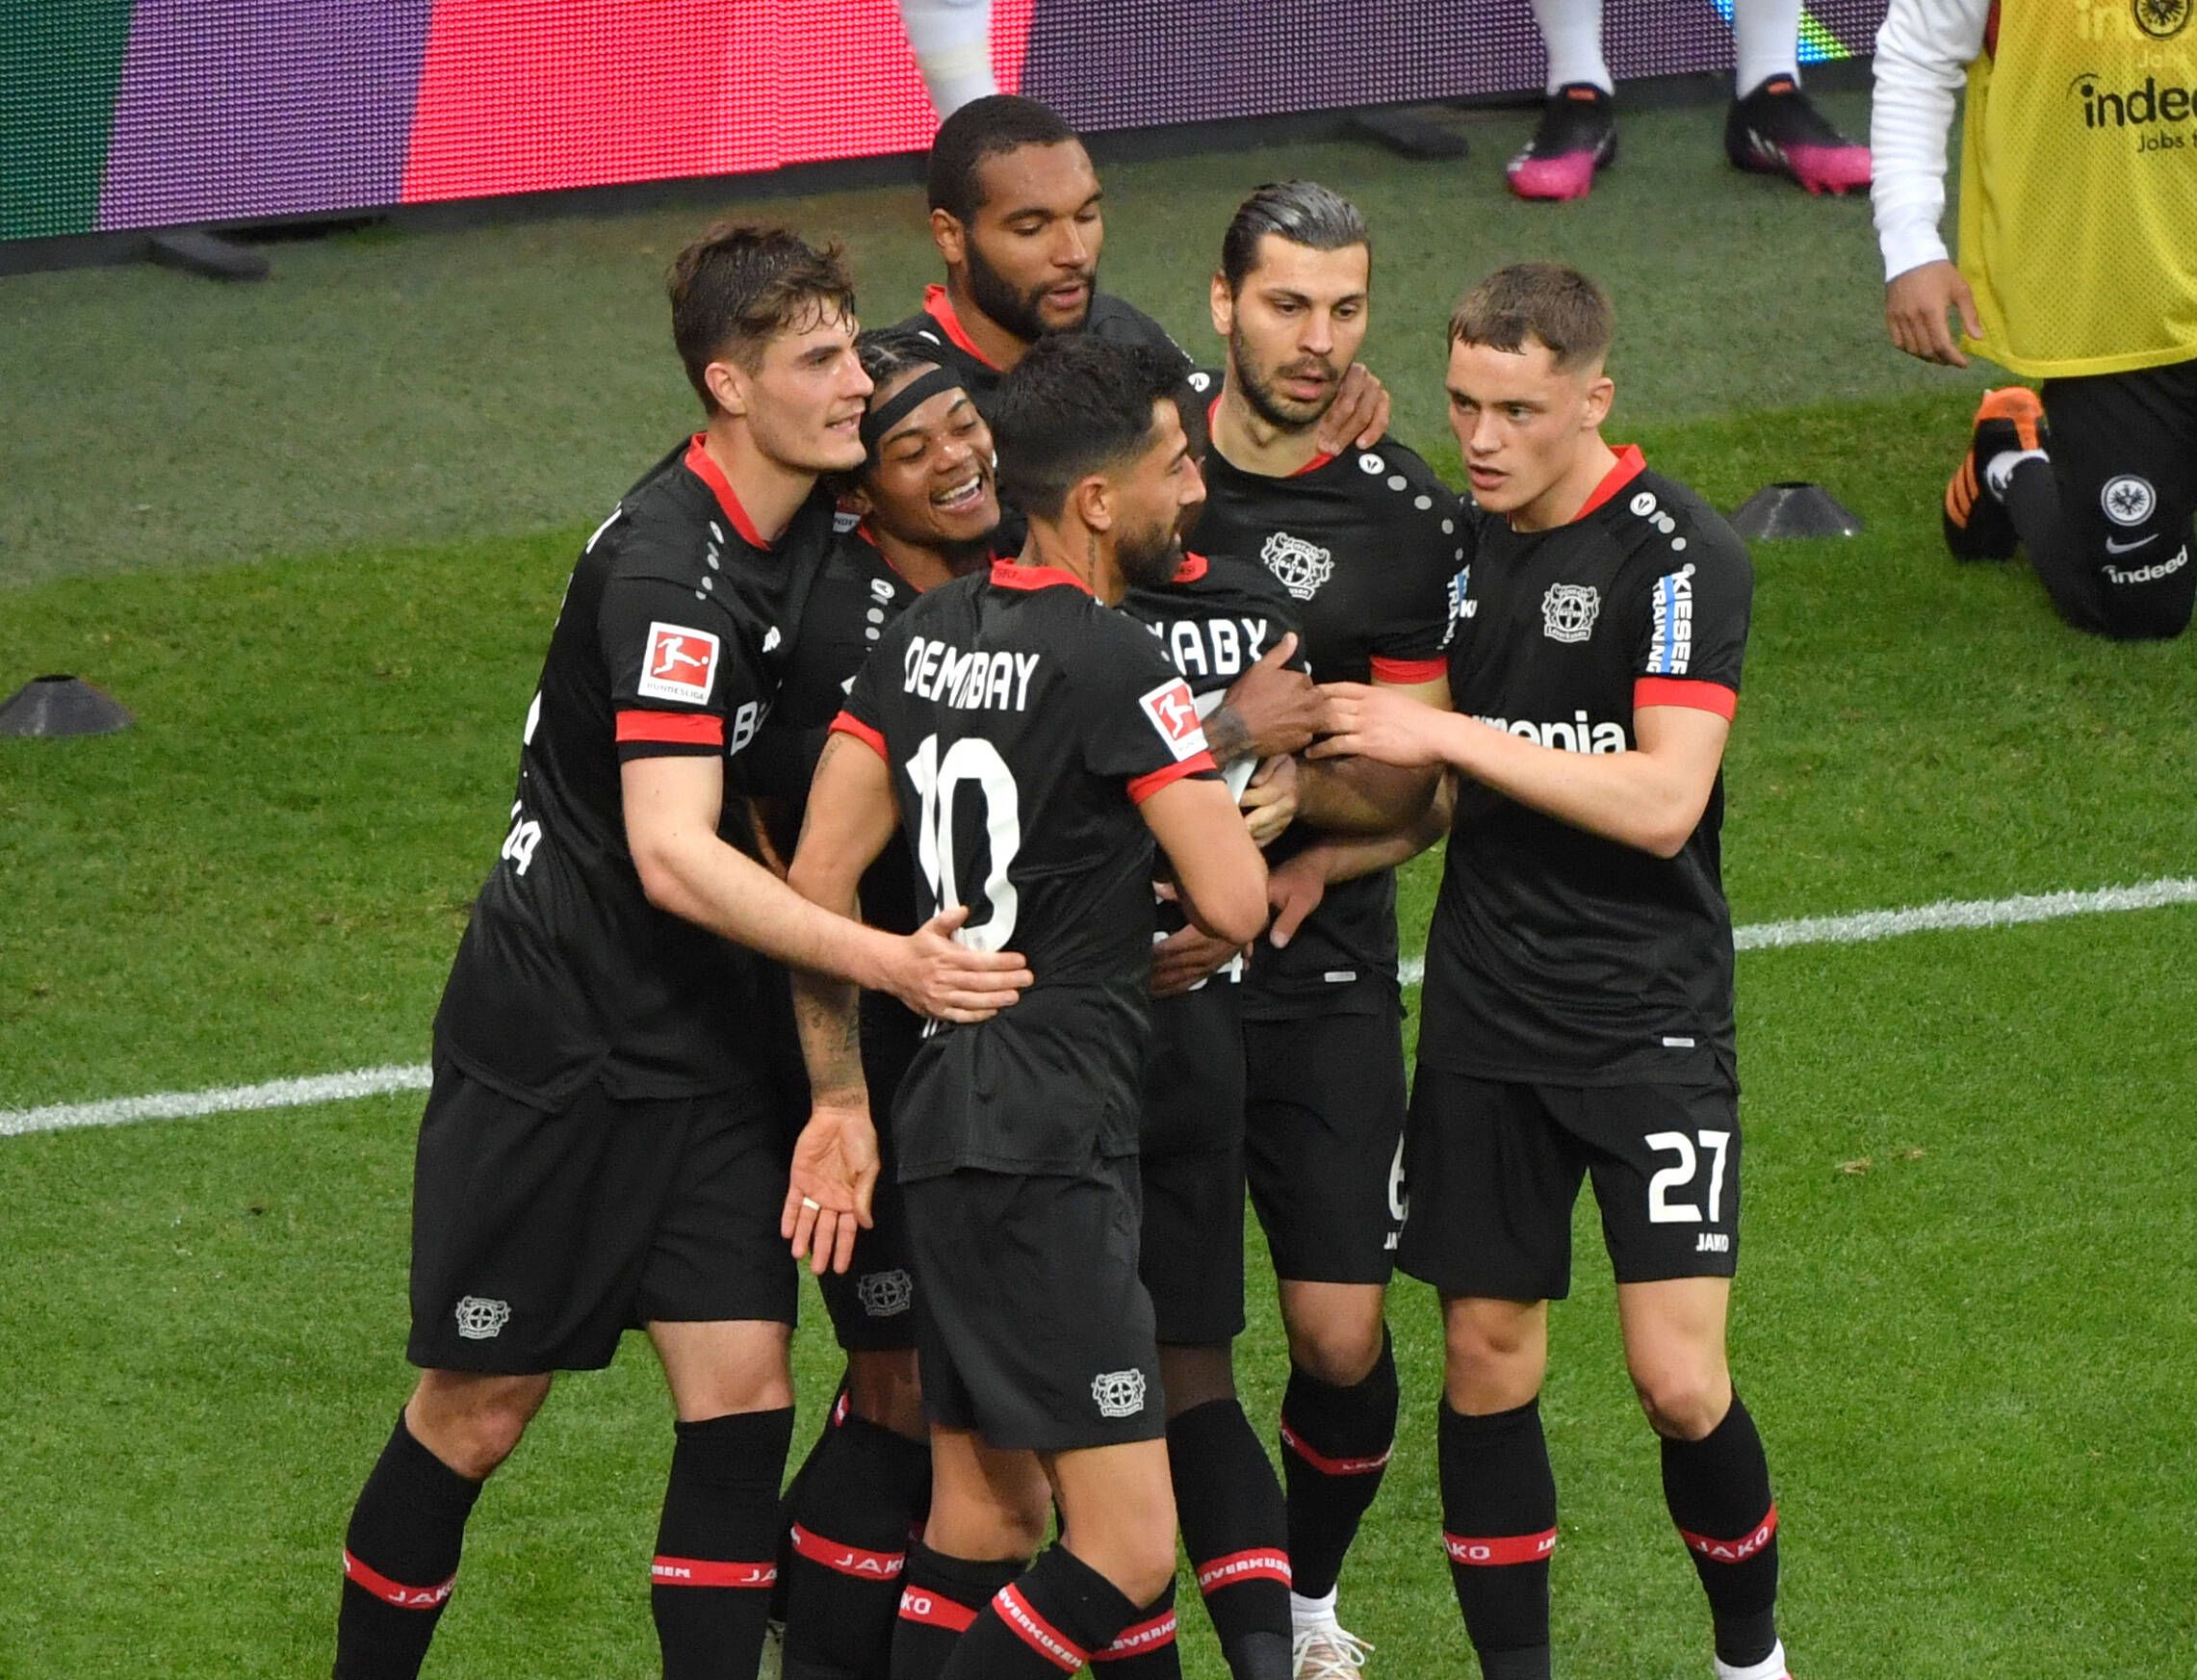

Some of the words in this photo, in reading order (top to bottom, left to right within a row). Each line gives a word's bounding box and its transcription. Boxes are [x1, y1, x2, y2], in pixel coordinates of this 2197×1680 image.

[2067, 73, 2197, 129] inde
[2137, 129, 2184, 153] Jobs
[2102, 543, 2188, 584] indeed
[1645, 577, 1667, 673] TRAINING
[1671, 570, 1693, 675] KIESER
[905, 733, 1021, 954] 10
[1644, 1129, 1731, 1223] 27
[1695, 1232, 1730, 1253] JAKO
[1696, 1526, 1769, 1559] JAKO
[388, 1579, 455, 1604] JAKO
